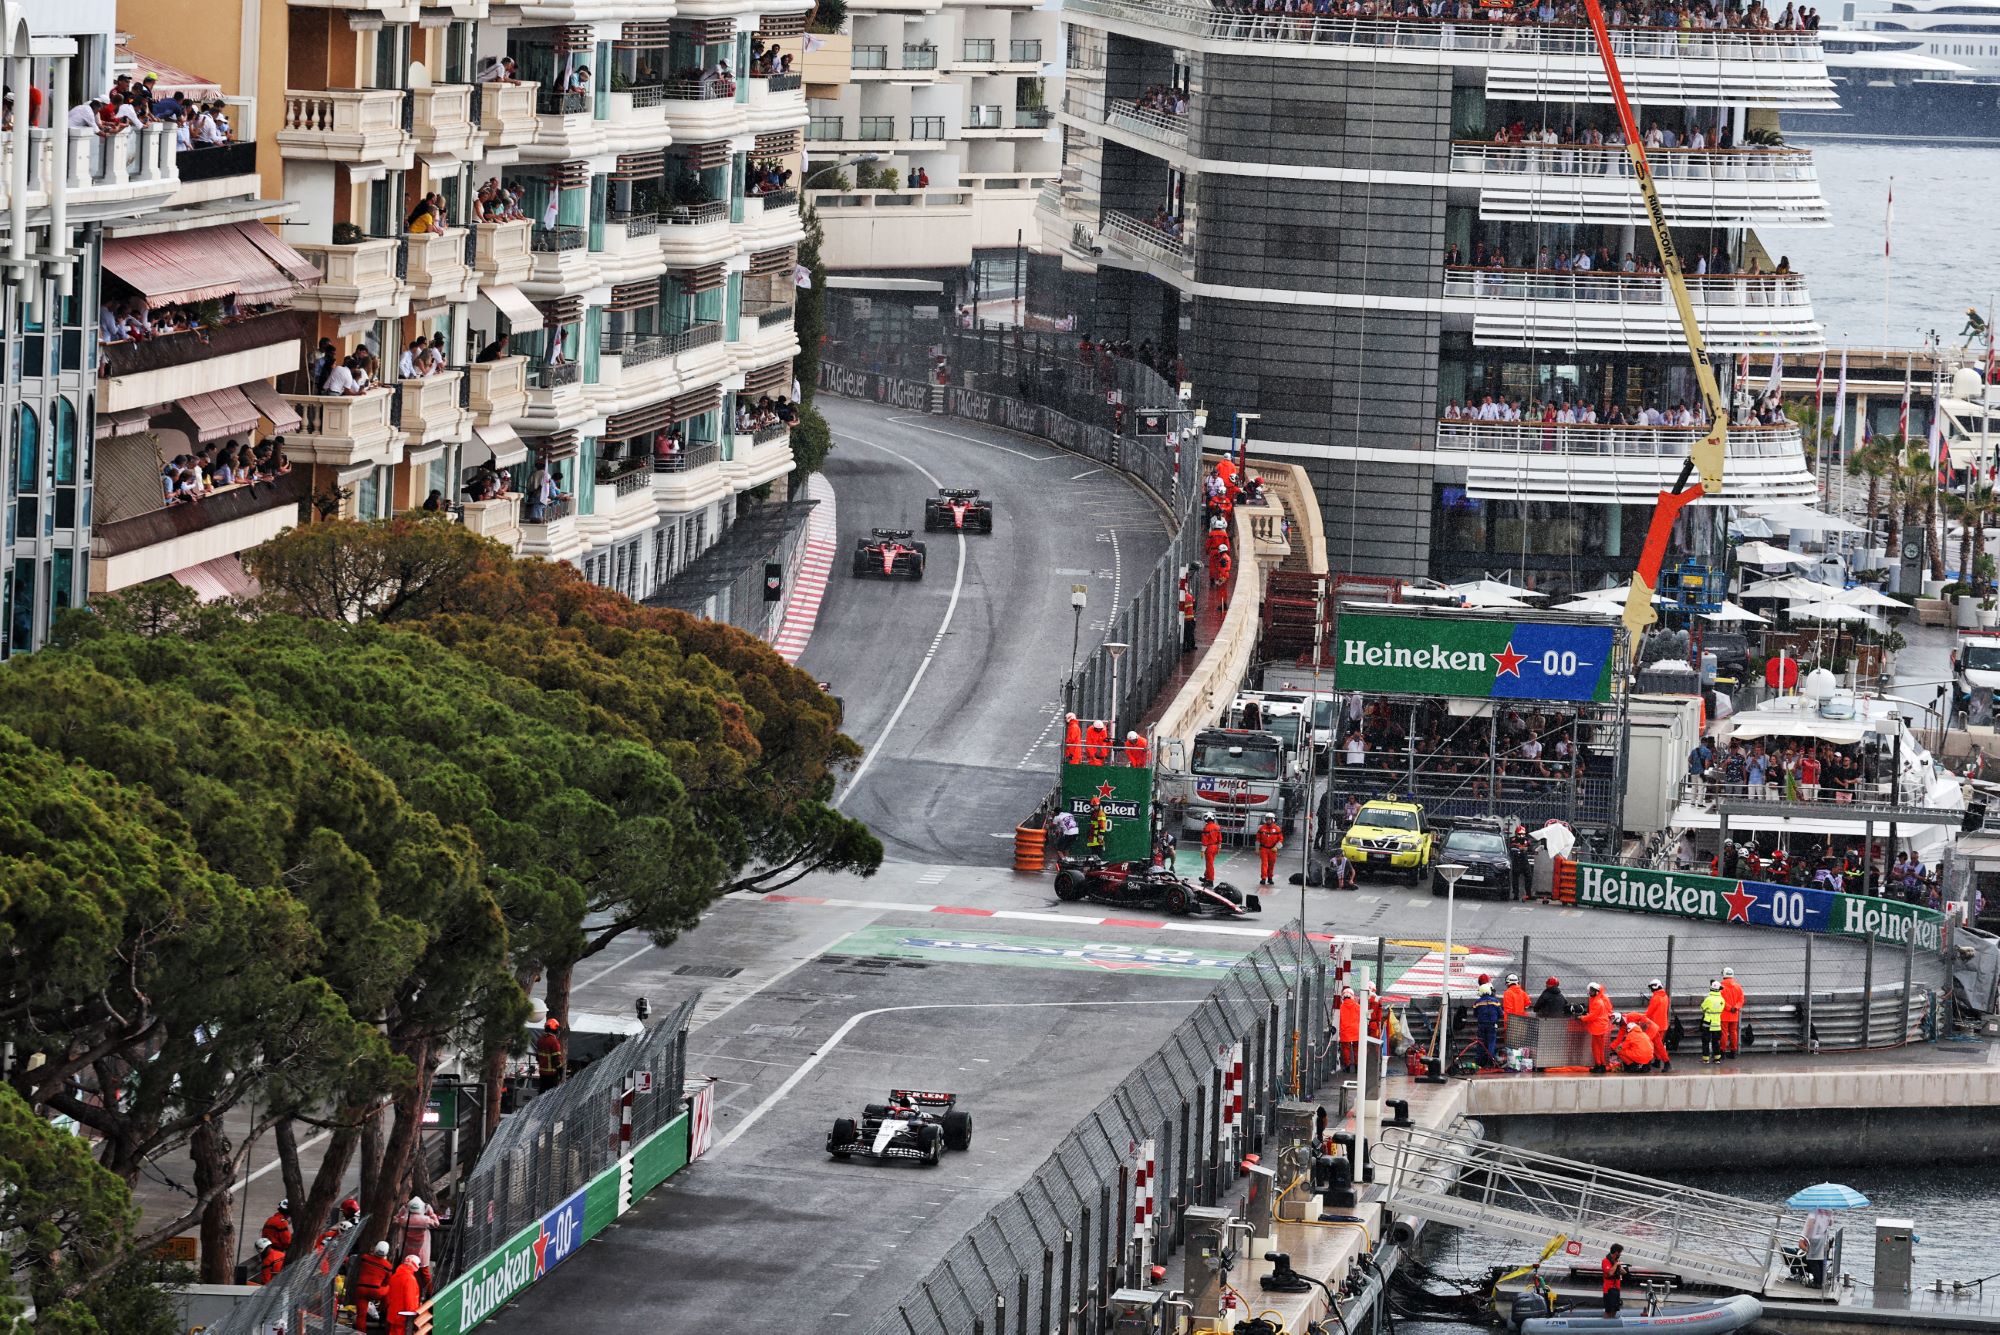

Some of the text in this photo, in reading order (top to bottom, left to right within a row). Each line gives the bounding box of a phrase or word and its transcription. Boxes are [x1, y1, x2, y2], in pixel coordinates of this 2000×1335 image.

[1696, 347, 1709, 366] JLG
[1343, 639, 1577, 677] Heineken 0.0
[1073, 800, 1136, 817] Heeken
[1581, 866, 1938, 951] Heineken 0.0 Heineken
[459, 1245, 531, 1334] Heineken
